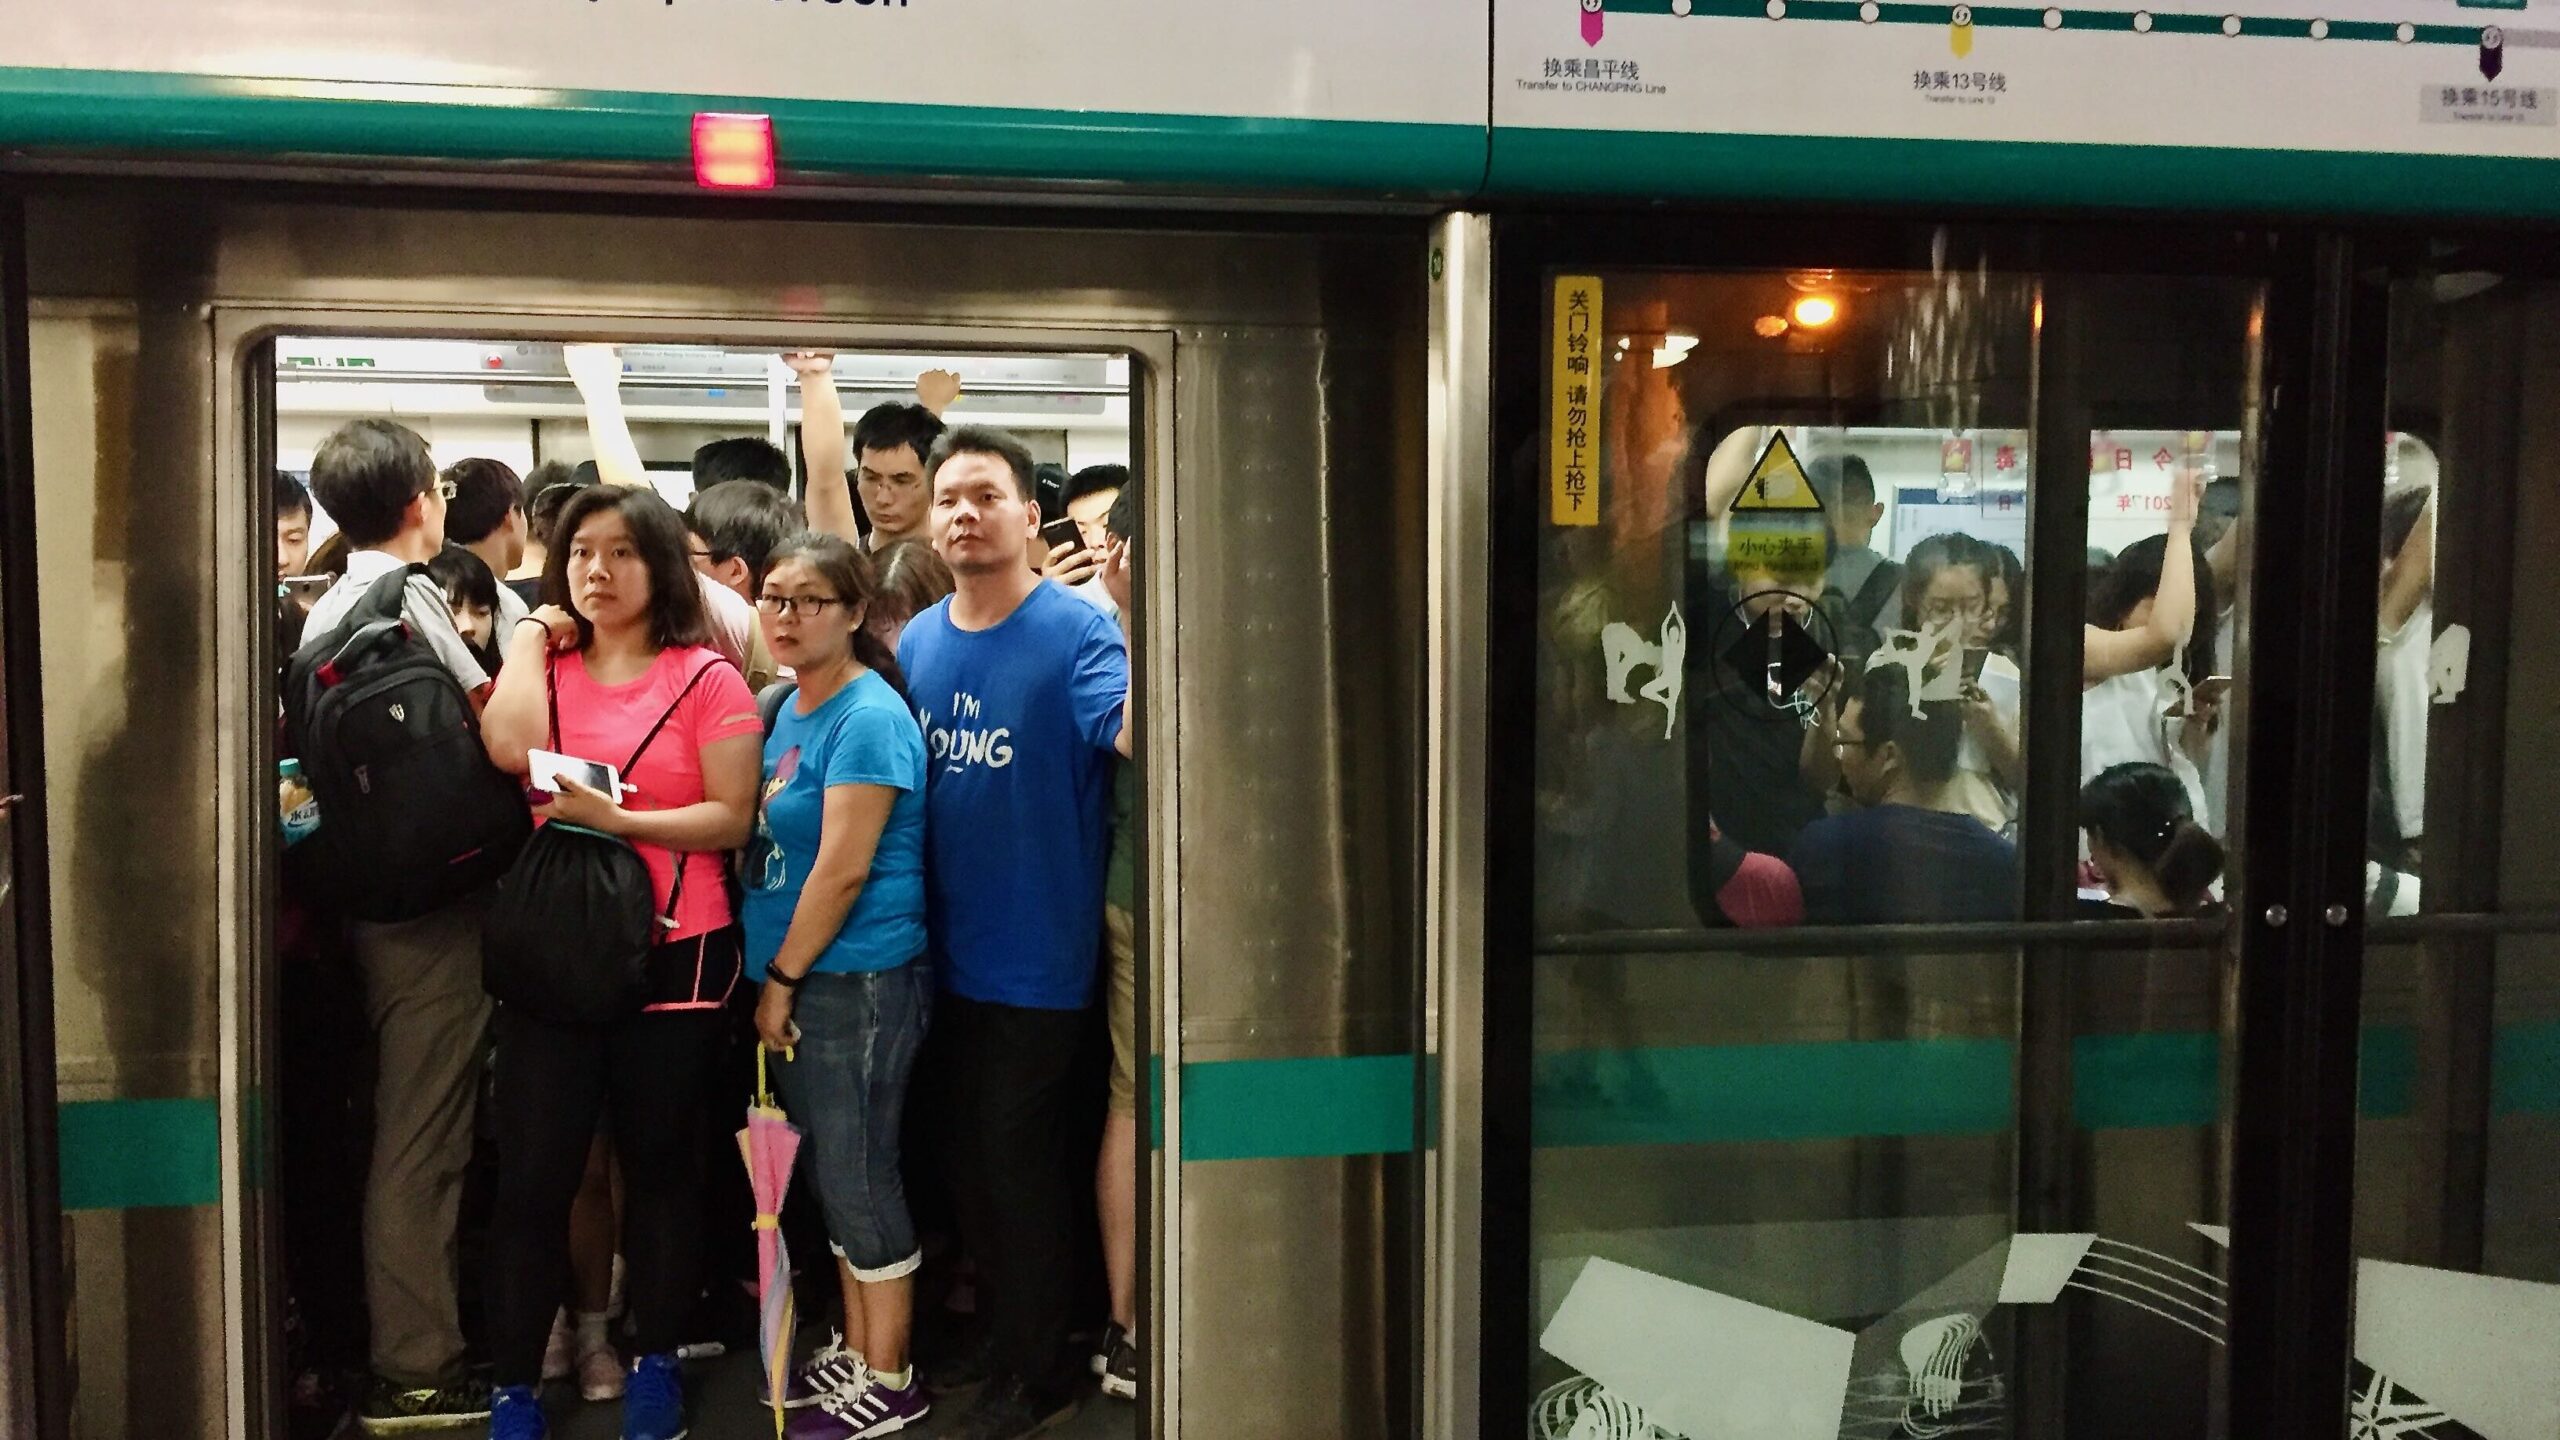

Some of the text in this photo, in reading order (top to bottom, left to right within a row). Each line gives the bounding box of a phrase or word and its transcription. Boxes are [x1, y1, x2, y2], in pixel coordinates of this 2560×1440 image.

[1543, 57, 1640, 80] 换乘昌平线
[1913, 70, 2006, 92] 换乘13号线
[1515, 79, 1666, 94] Transfer to CHANGPING Line
[1565, 290, 1589, 511] 关门铃响 请勿抢上抢下
[953, 691, 980, 720] I'M
[919, 707, 1013, 769] YOUNG
